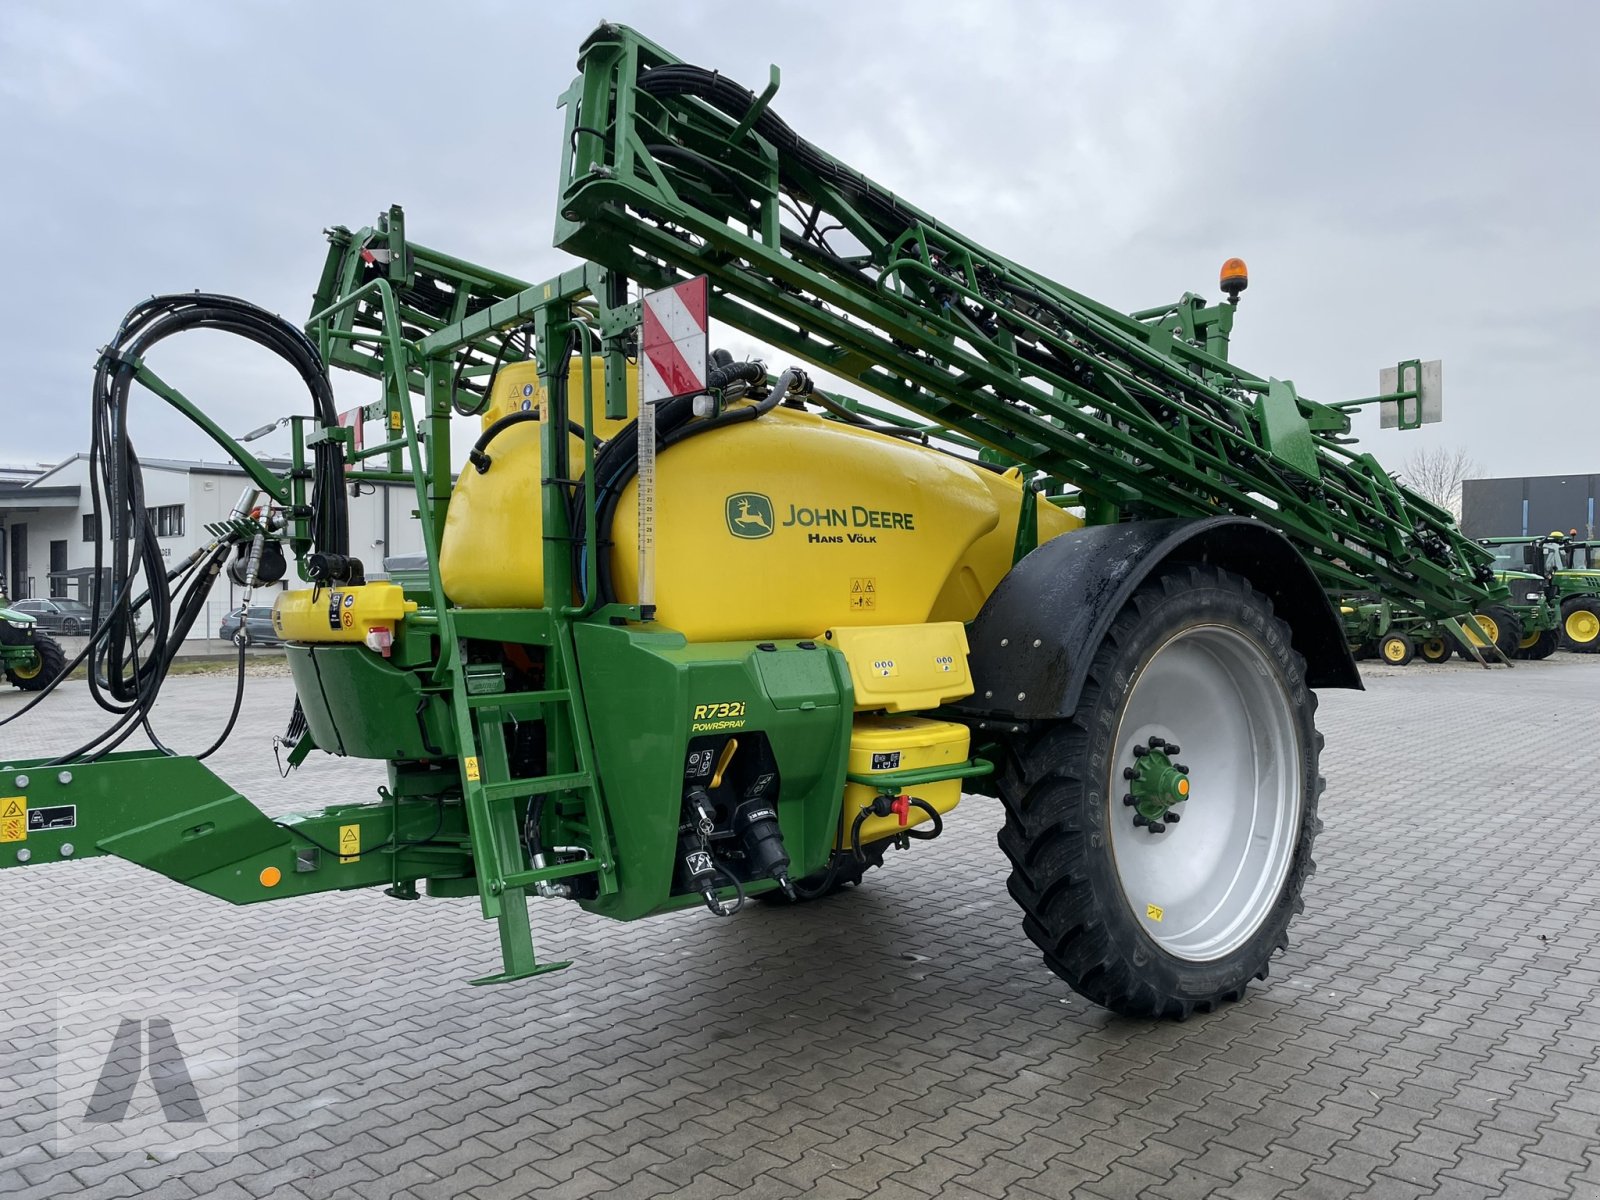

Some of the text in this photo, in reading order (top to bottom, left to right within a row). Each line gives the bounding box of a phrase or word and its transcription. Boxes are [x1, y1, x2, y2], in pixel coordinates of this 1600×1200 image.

[782, 503, 915, 531] JOHN DEERE
[807, 533, 877, 544] HANS VÖLK
[693, 701, 746, 720] R732i
[691, 719, 746, 732] POWRSPRAY
